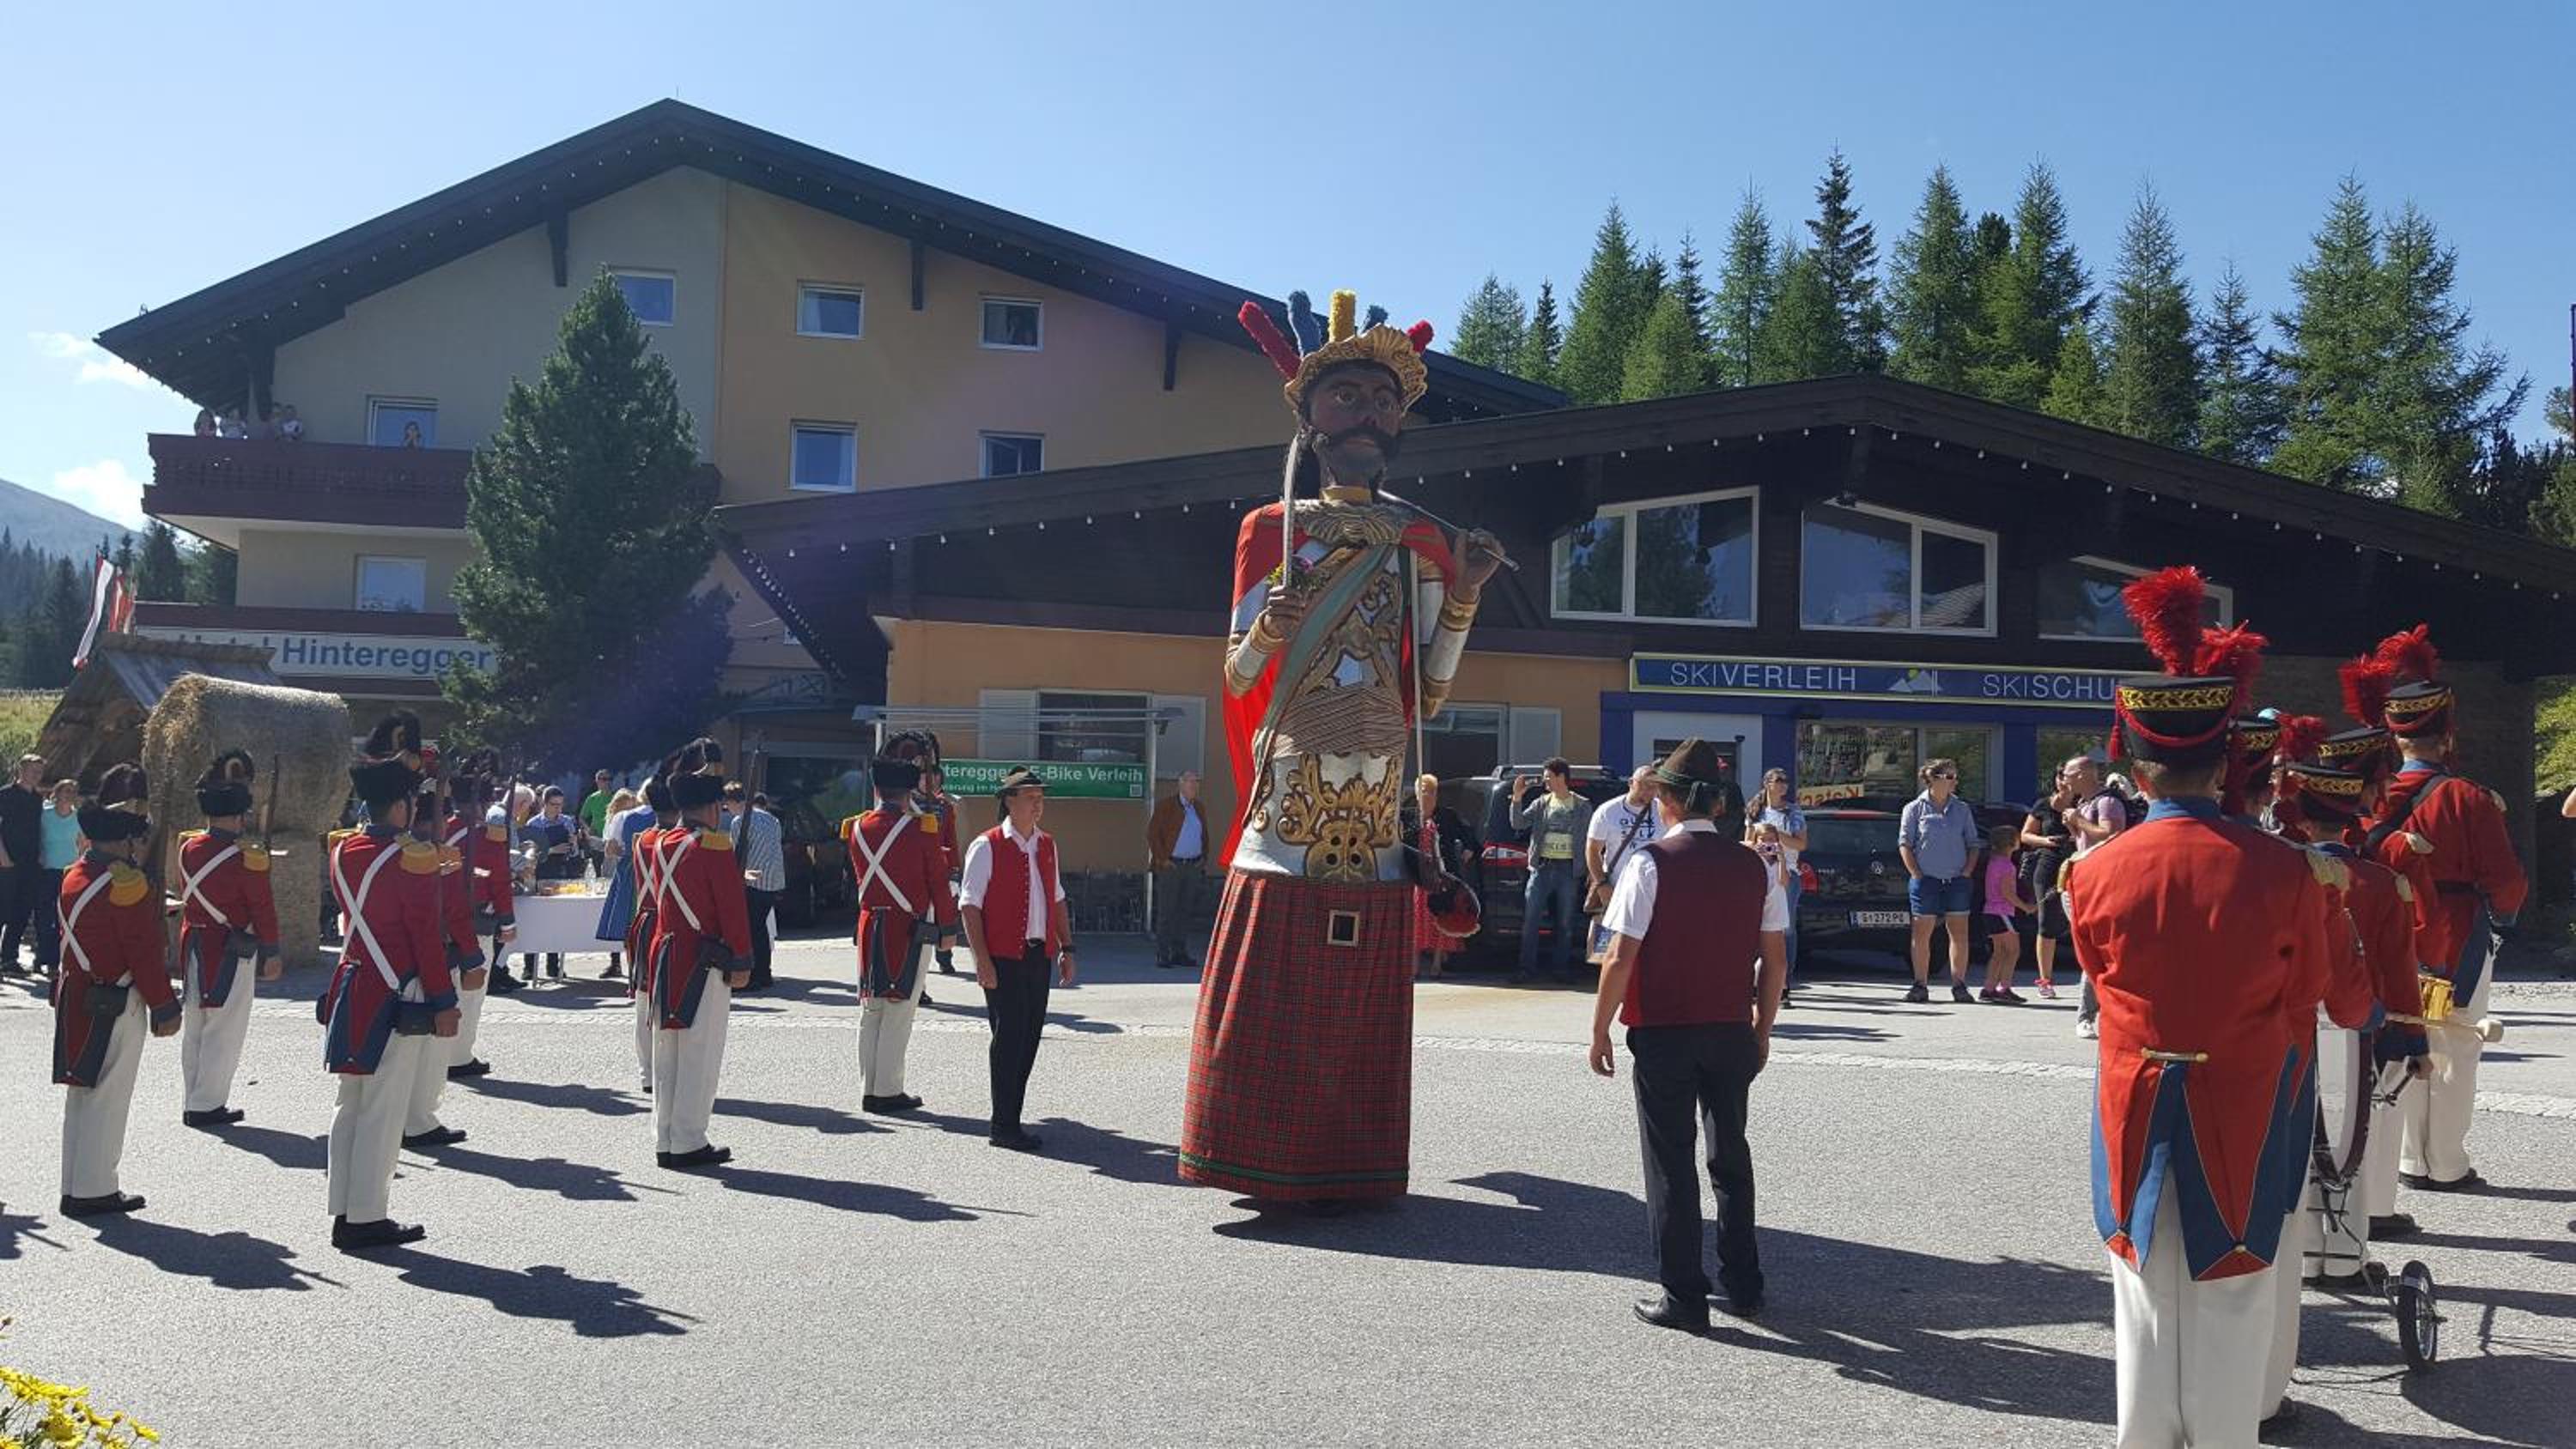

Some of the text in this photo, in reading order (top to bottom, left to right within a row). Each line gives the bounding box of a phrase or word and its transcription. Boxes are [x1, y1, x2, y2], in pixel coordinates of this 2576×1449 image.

[282, 638, 493, 676] Hinteregger
[1670, 662, 1856, 691] SKIVERLEIH
[1983, 674, 2116, 700] SKISCHU
[942, 764, 1143, 782] teregge E-Bike Verleih
